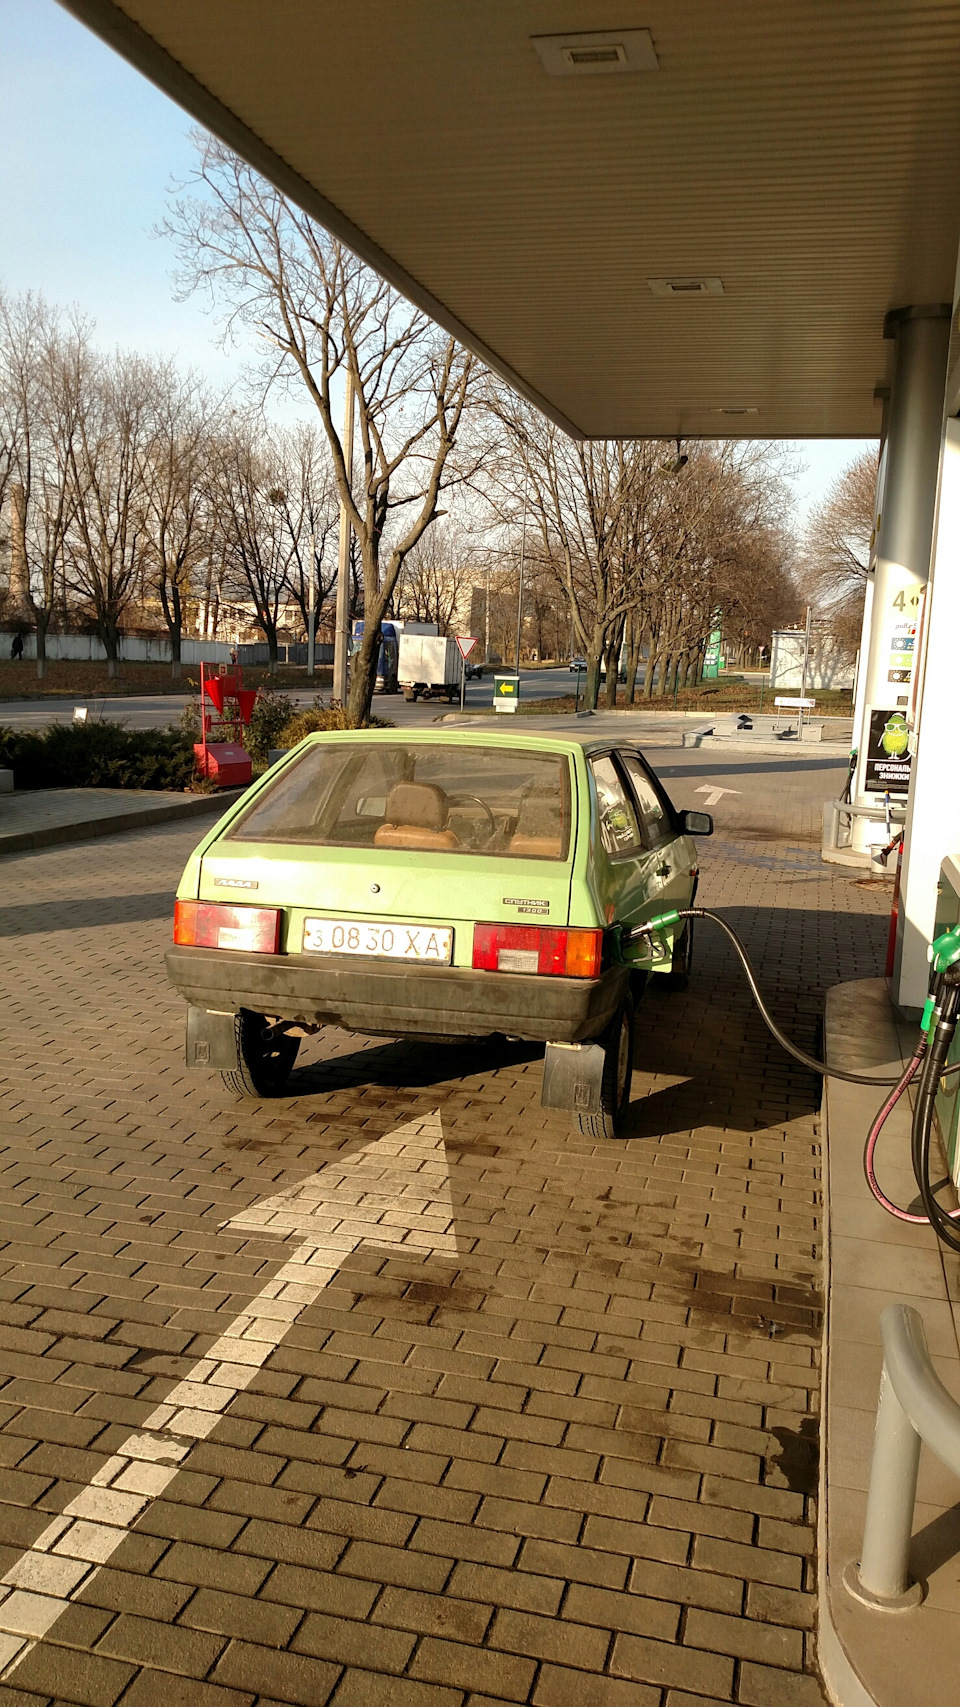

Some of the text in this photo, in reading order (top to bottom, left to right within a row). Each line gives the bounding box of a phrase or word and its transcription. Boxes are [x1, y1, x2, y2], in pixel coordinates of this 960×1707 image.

[893, 590, 906, 611] 4
[878, 772, 910, 780] ЗНИЖКИ
[504, 898, 546, 906] СПУТНИК
